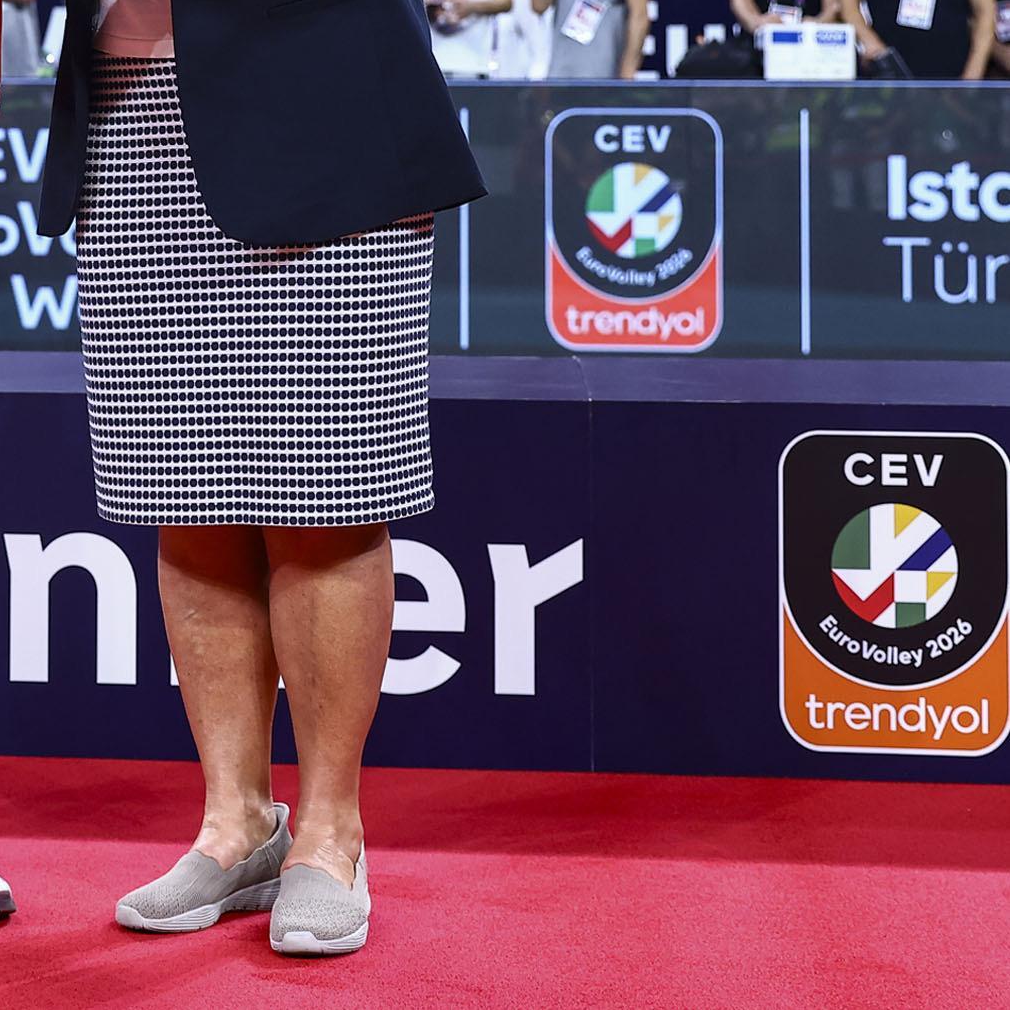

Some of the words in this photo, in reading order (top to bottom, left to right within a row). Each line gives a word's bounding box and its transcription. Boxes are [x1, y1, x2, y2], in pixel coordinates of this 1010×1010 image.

[593, 124, 671, 153] CEV
[575, 245, 656, 287] EuroVolley
[565, 305, 705, 340] trendyol
[844, 452, 944, 487] CEV
[818, 614, 923, 668] EuroVolley
[925, 617, 974, 659] 2026
[805, 693, 989, 741] trendyol
